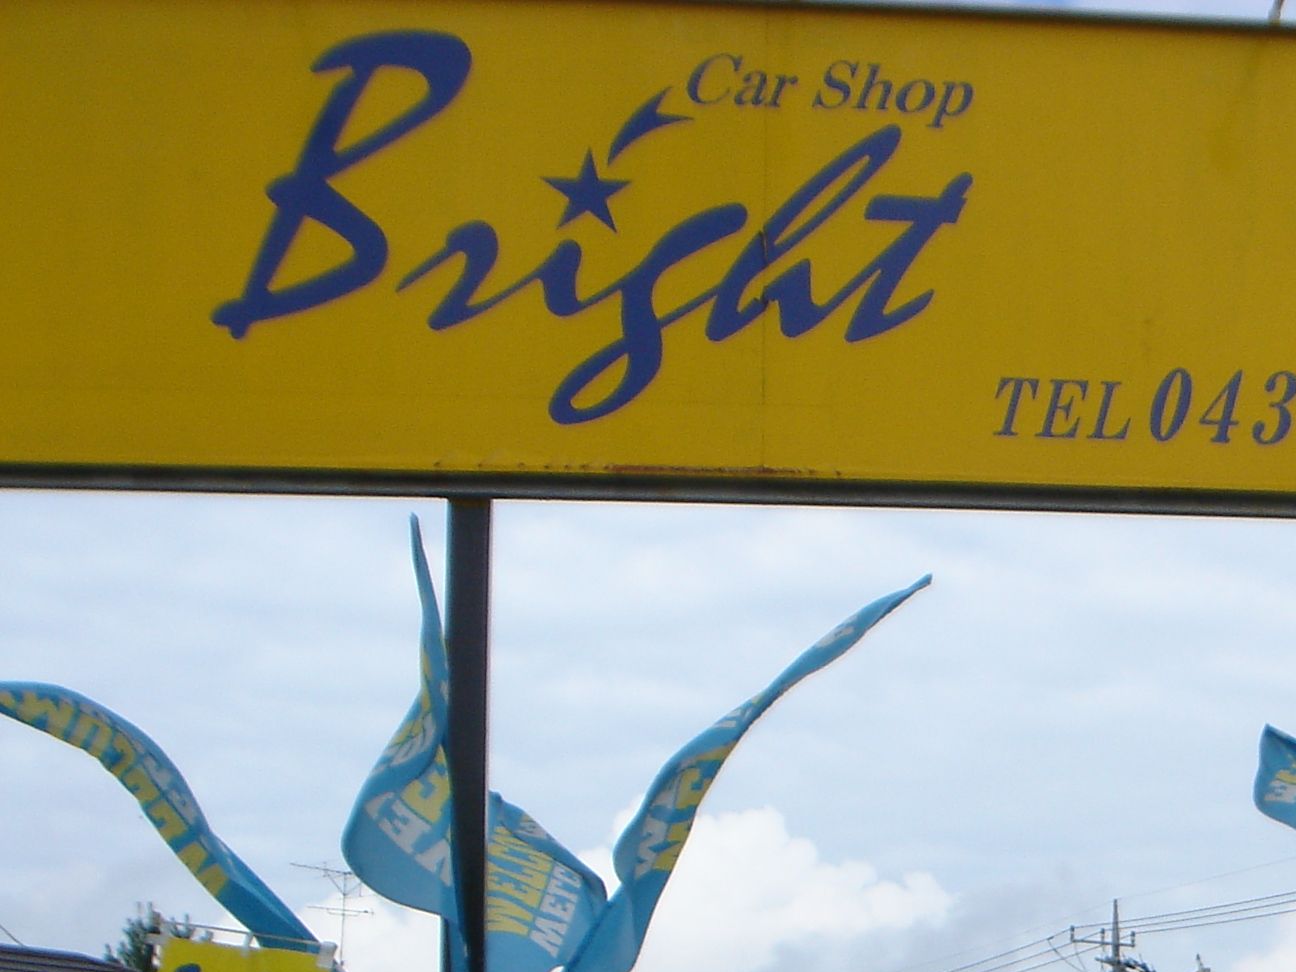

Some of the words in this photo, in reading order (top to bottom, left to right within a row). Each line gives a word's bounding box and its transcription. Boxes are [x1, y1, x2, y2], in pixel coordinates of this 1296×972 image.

[686, 53, 799, 109] Car
[811, 60, 975, 129] Shop
[209, 28, 975, 425] Bright
[993, 376, 1134, 442] TEL
